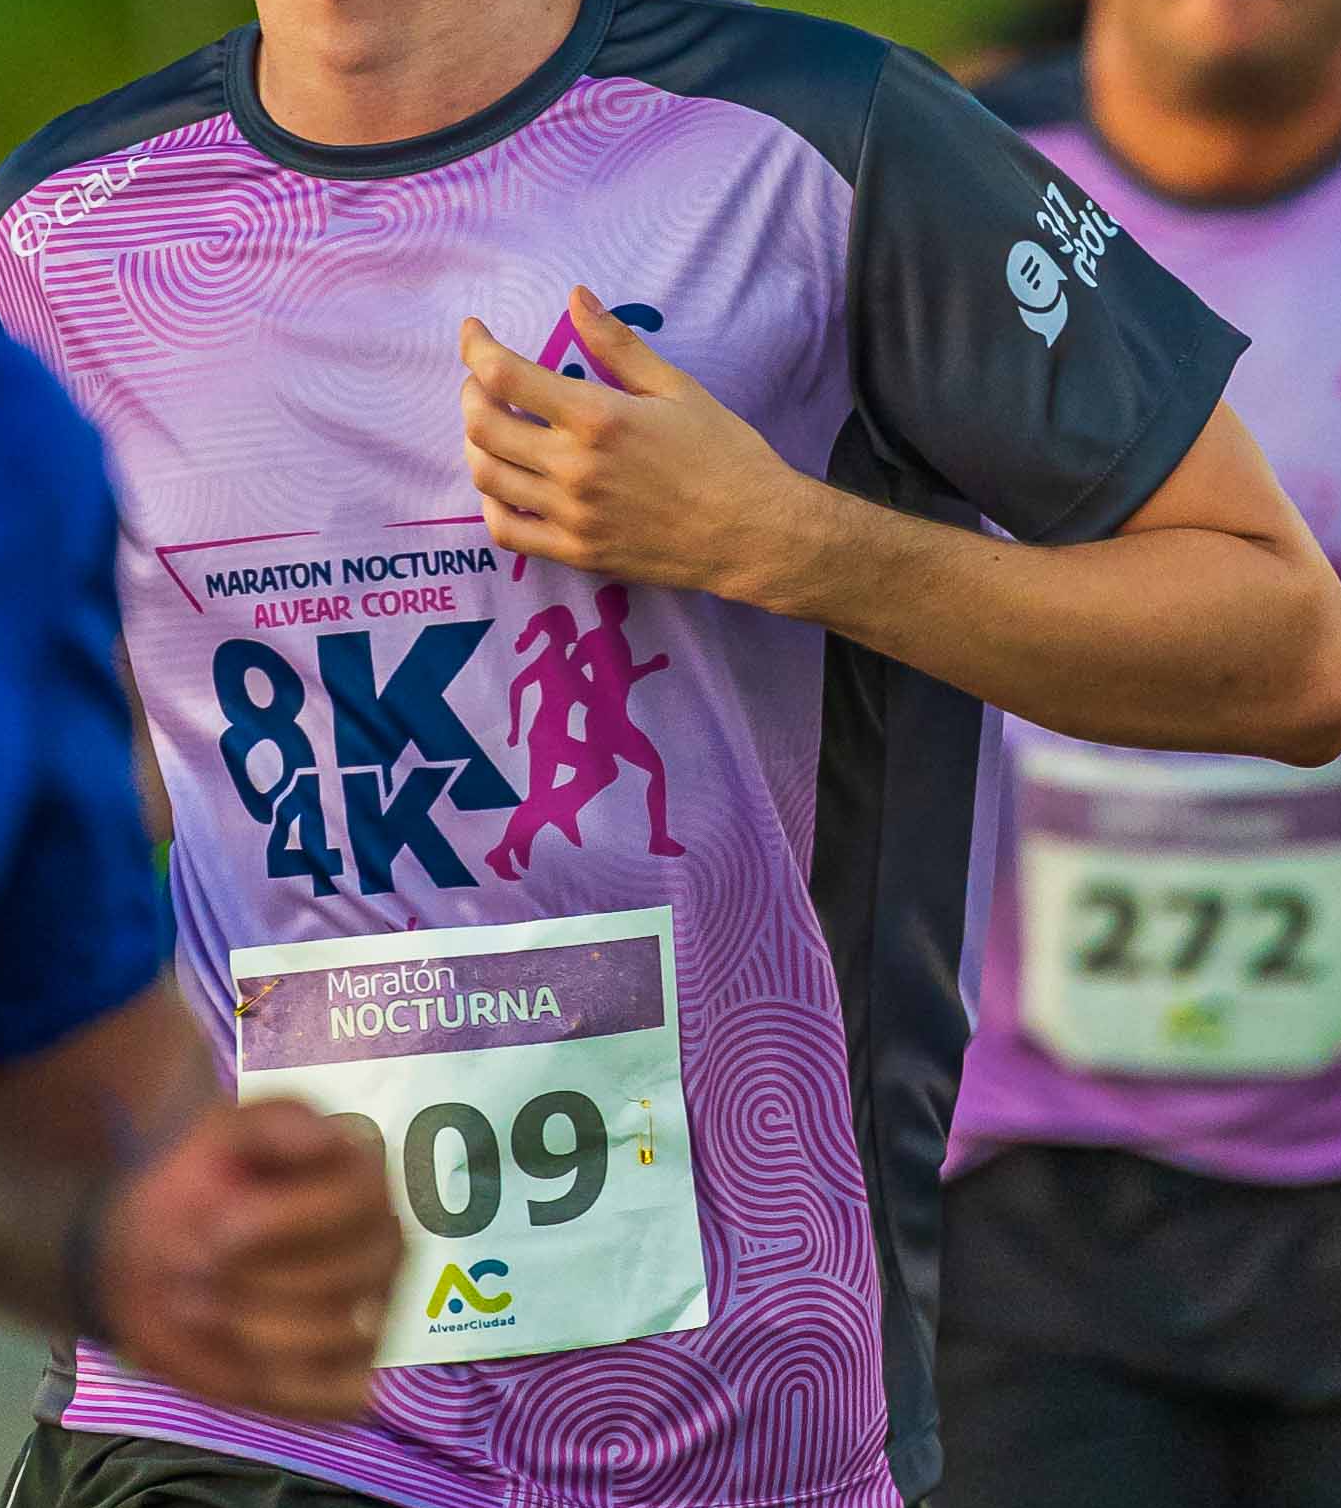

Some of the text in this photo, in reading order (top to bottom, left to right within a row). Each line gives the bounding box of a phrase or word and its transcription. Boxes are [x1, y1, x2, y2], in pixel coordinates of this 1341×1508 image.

[205, 547, 498, 598] MARATON NOCTURNA
[254, 585, 456, 629] ALVEAR CORRE
[212, 618, 524, 825] 8K
[266, 766, 481, 898] 4K
[1071, 880, 1324, 983] 272
[327, 960, 456, 1001] Maratón
[328, 986, 562, 1040] NOCTURNA
[428, 1315, 516, 1334] AlvearCiudad
